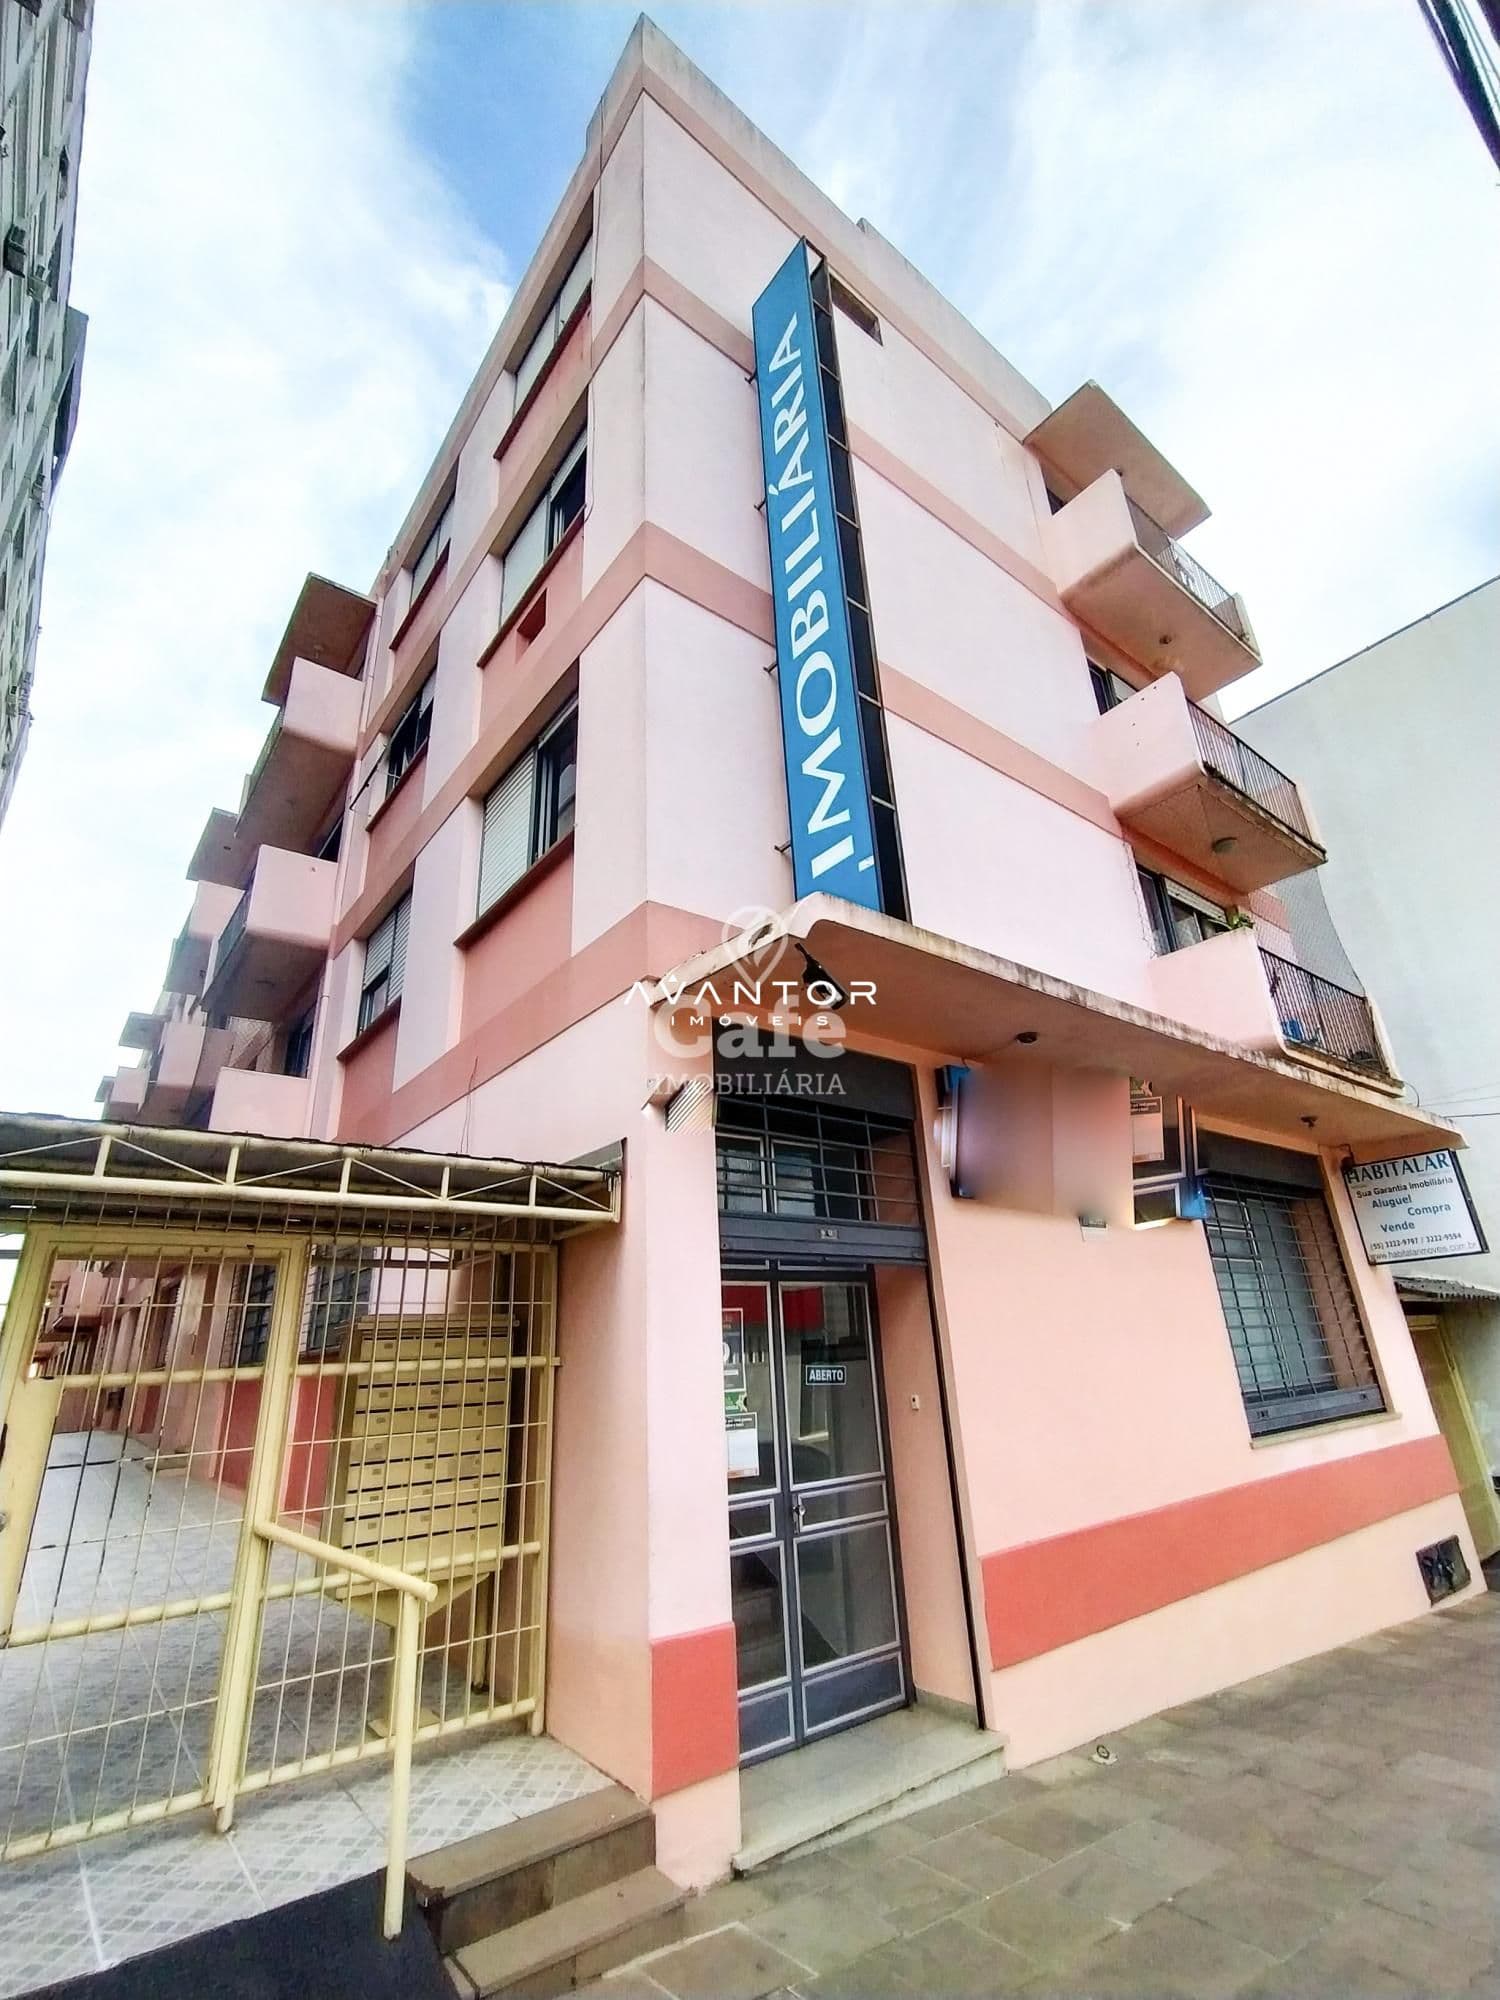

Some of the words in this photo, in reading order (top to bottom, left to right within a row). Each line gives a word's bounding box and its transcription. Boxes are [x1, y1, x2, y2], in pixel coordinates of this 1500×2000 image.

[769, 312, 855, 879] IMOBILIÁRIA
[1345, 1152, 1450, 1184] HABITALAR
[1356, 1189, 1372, 1199] Sua
[1374, 1183, 1408, 1195] Garantia
[1372, 1194, 1412, 1208] Aluguel
[1407, 1203, 1451, 1216] Compra
[1380, 1220, 1415, 1233] Vende
[808, 1369, 844, 1382] ABERTO
